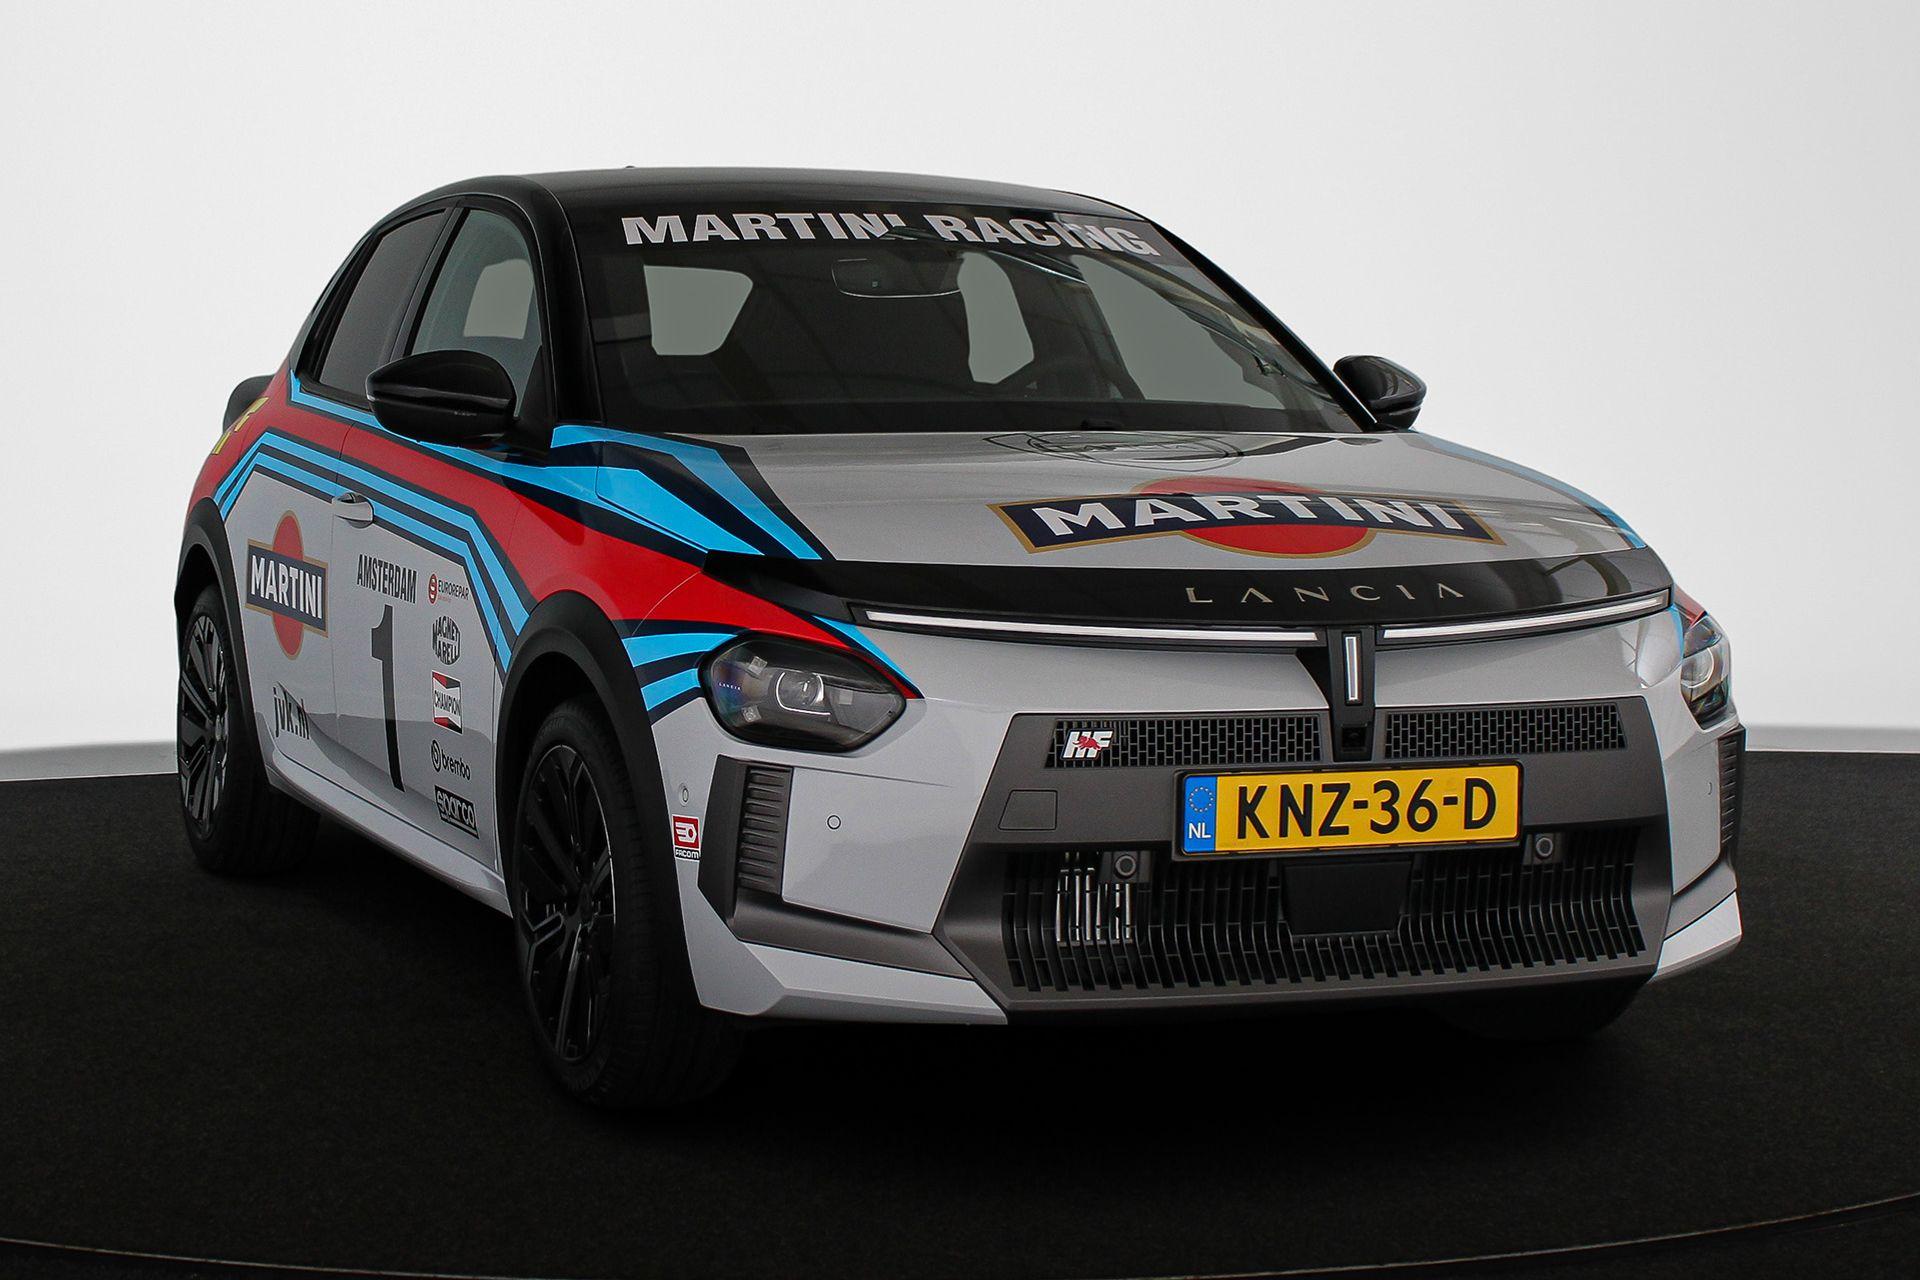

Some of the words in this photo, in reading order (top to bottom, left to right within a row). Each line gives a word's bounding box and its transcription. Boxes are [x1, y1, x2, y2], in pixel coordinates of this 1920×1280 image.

[923, 214, 1161, 257] RACING
[1031, 494, 1465, 537] MARTINI
[251, 554, 323, 620] MARTINI
[356, 553, 418, 604] AMSTERDAM
[438, 579, 470, 601] EUROREPAR
[1186, 582, 1465, 604] LANCIA
[371, 604, 406, 793] 1
[434, 689, 462, 717] CHAMPION
[1062, 730, 1114, 759] HF
[442, 748, 471, 781] brembo
[436, 790, 475, 829] sparco
[1236, 777, 1497, 840] KNZ-36-D
[1188, 822, 1212, 840] NL
